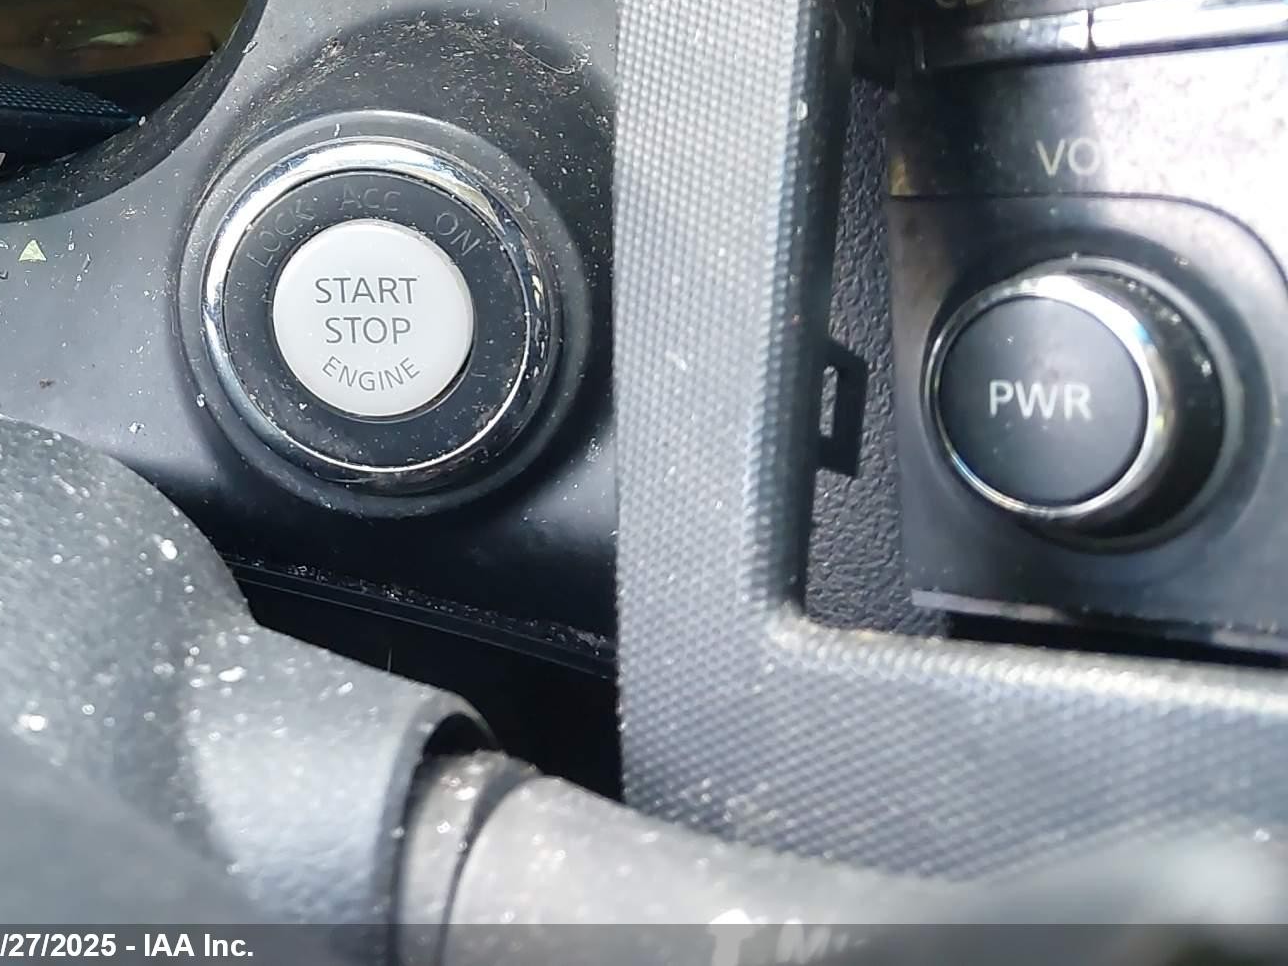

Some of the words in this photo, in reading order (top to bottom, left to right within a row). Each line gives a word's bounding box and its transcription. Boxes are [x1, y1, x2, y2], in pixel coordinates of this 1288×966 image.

[340, 185, 400, 211] ACC
[247, 202, 314, 268] LOCK
[436, 213, 480, 256] ON
[315, 278, 416, 304] START
[324, 316, 411, 344] STOP
[322, 356, 420, 390] ENGINE
[989, 380, 1093, 420] PWR
